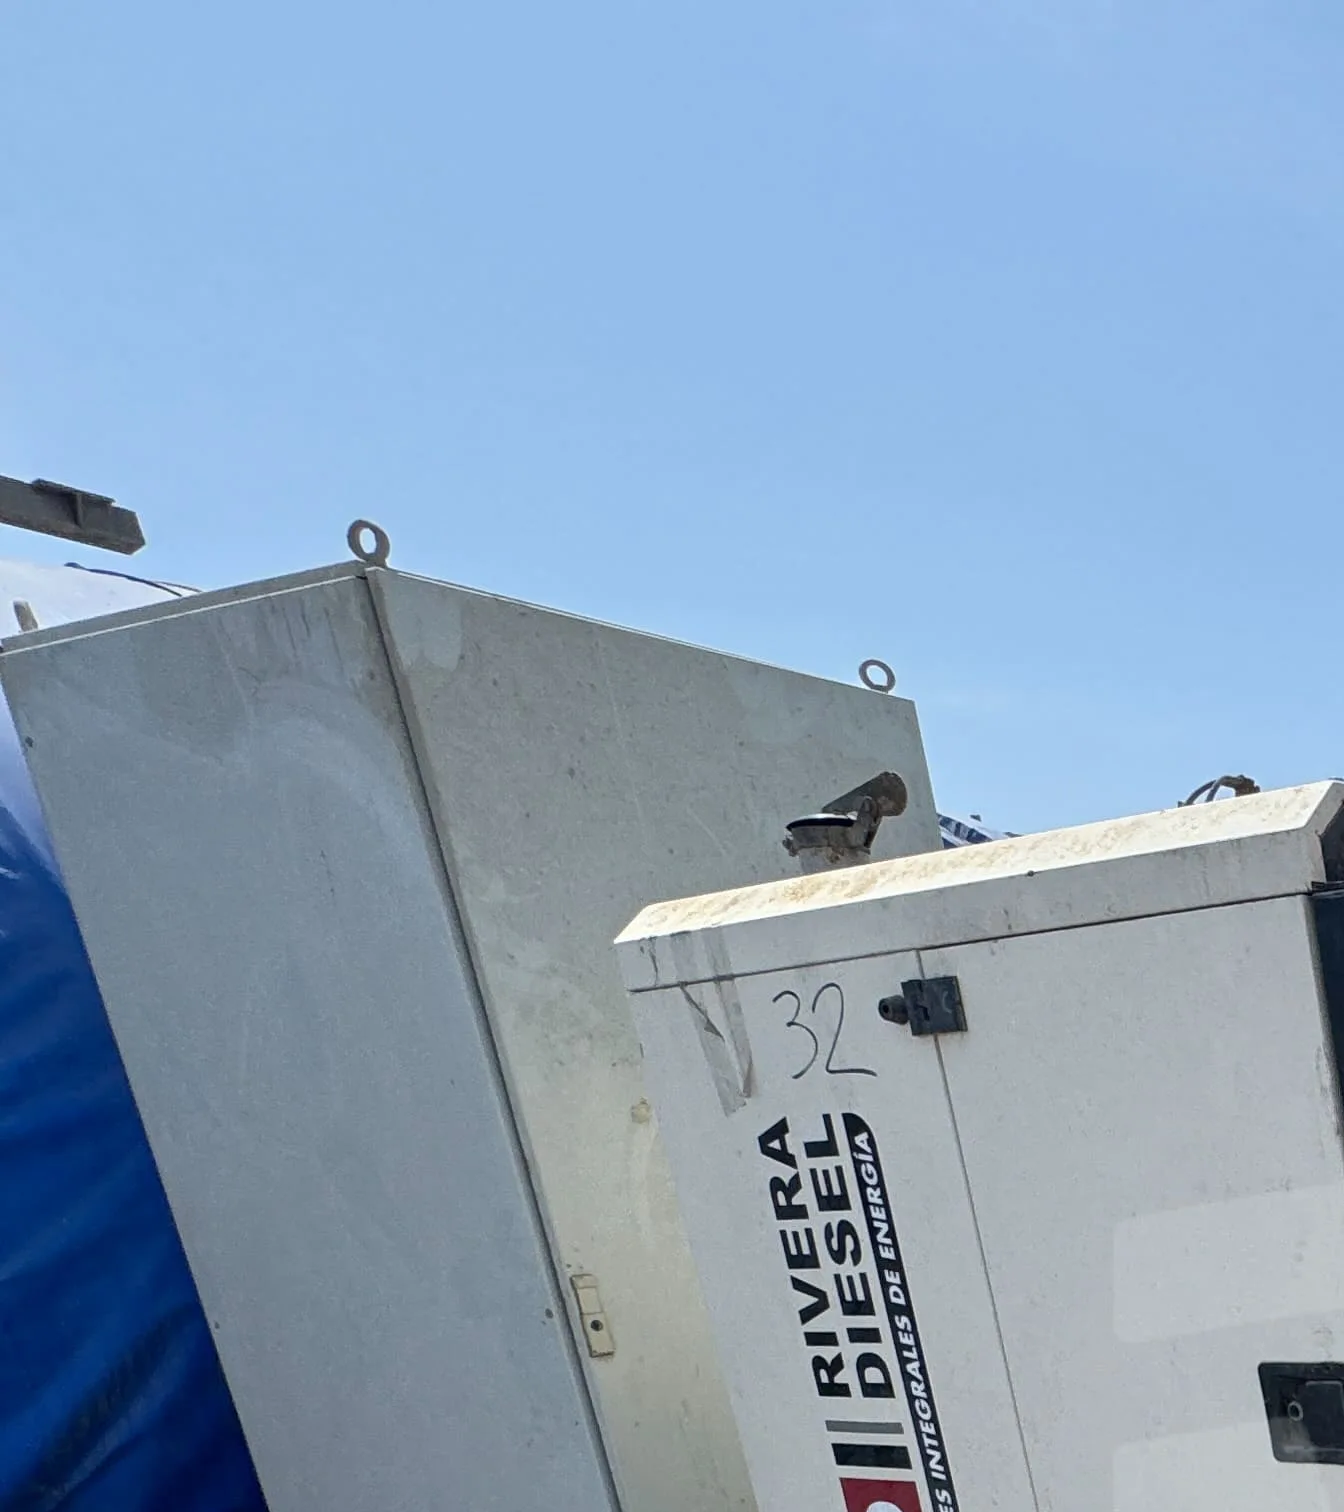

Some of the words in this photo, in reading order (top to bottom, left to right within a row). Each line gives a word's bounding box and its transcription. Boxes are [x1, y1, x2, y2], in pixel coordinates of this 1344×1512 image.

[772, 982, 877, 1079] 32
[758, 1116, 852, 1397] RIVERA
[804, 1113, 896, 1398] DIESEL
[853, 1131, 897, 1261] ENERGÍA
[889, 1269, 906, 1306] DE
[895, 1314, 947, 1479] INTEGRALES
